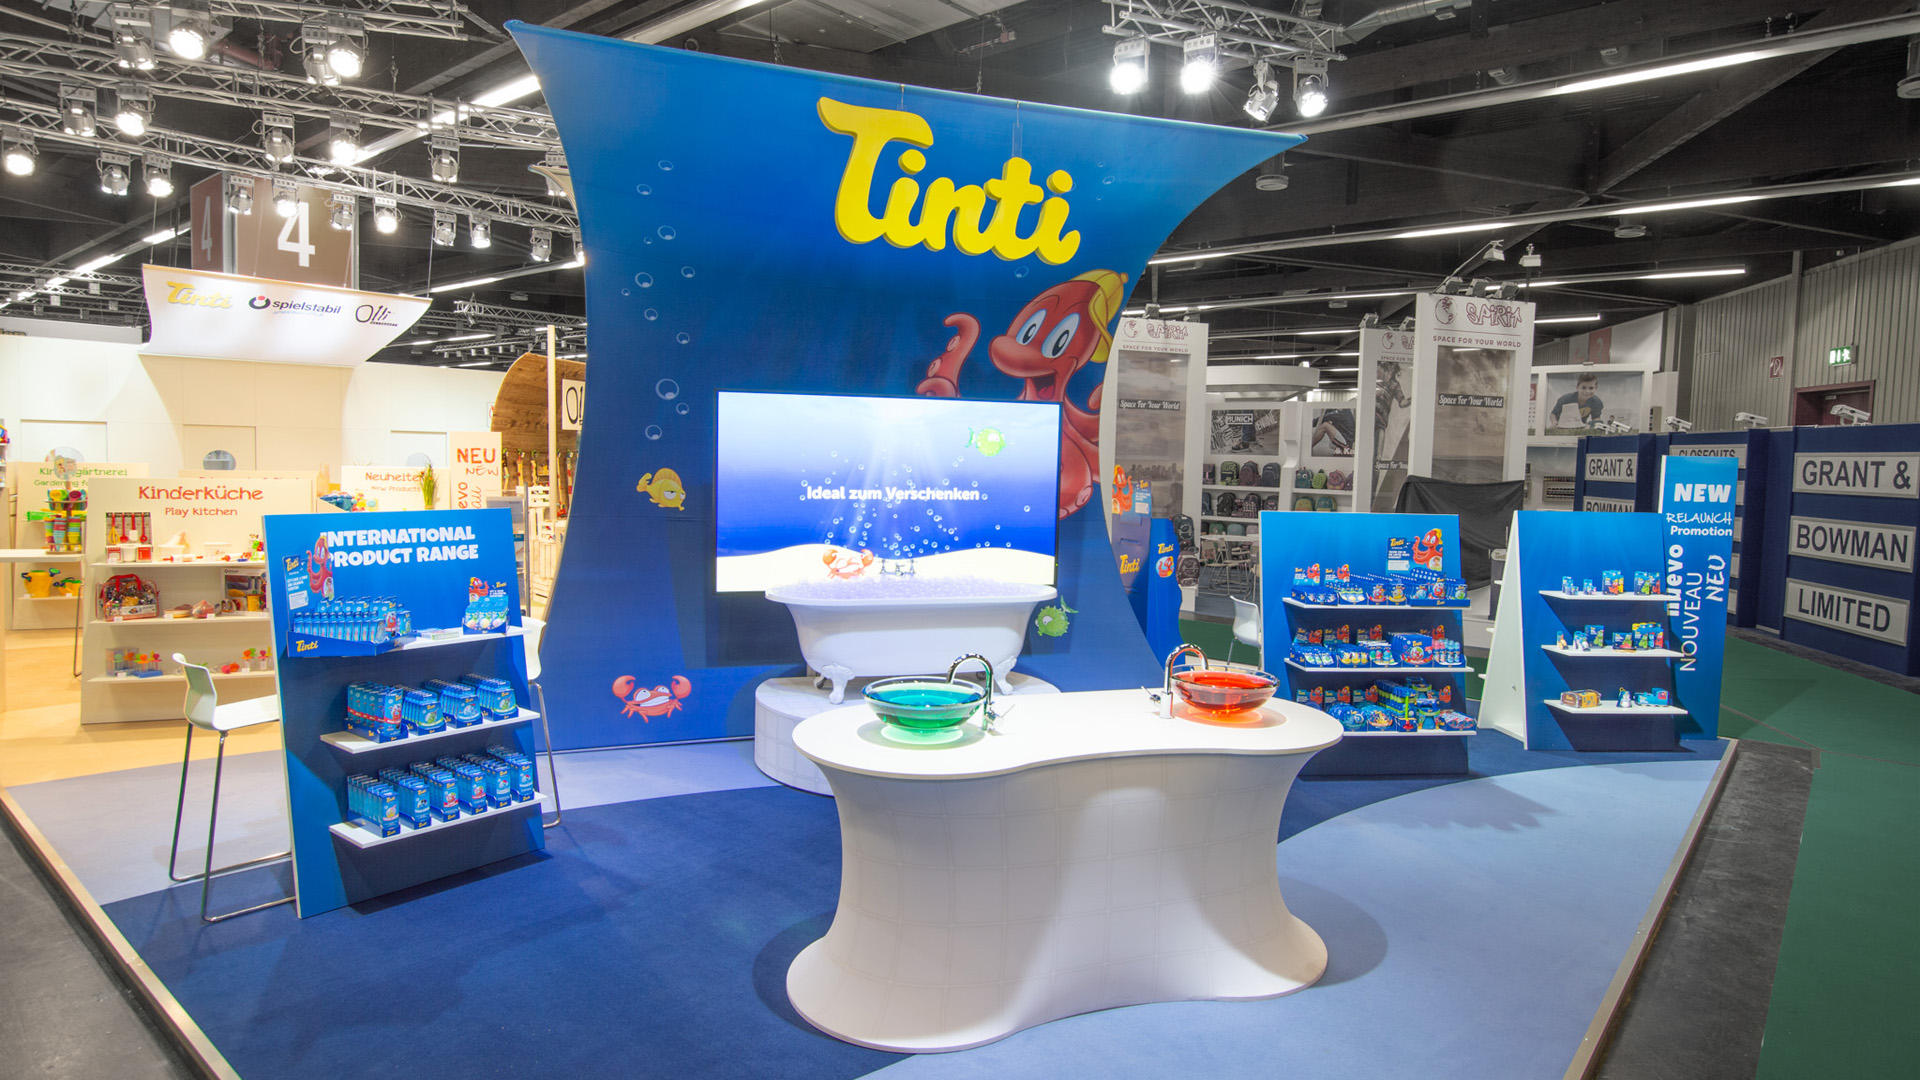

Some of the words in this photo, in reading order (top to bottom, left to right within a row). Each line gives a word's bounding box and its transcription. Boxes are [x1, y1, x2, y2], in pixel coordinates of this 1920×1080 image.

[817, 97, 1080, 265] Tinti
[202, 196, 212, 261] 4
[277, 202, 315, 267] 4
[167, 281, 233, 308] Tinti
[272, 300, 342, 314] spielstabil
[1475, 338, 1494, 346] YOUR
[1496, 340, 1521, 348] WORLD
[1120, 400, 1136, 410] Space
[1137, 400, 1147, 408] For
[1148, 401, 1161, 409] Your
[1162, 401, 1180, 410] World
[1439, 395, 1457, 406] Space
[1458, 396, 1467, 404] For
[1468, 396, 1483, 406] Your
[1483, 397, 1503, 407] World
[1225, 414, 1253, 424] MUNICH
[457, 448, 495, 463] NEU
[40, 467, 127, 478] Kingärtnerei
[466, 465, 498, 476] NEW
[1375, 461, 1390, 471] Space
[1589, 458, 1624, 476] GRANT
[1625, 459, 1633, 477] &
[1802, 460, 1886, 488] GRANT
[1893, 461, 1911, 490] &
[138, 485, 264, 500] Kinderküche
[806, 486, 846, 500] Ideal
[848, 489, 883, 500] zum
[885, 487, 980, 501] Verschenken
[1674, 483, 1732, 503] NEW
[165, 507, 189, 518] Play
[1666, 511, 1733, 525] RELAUNCH
[320, 526, 476, 547] NTERNATIONAL
[1670, 525, 1733, 536] Promotion
[1158, 543, 1175, 554] Tinti
[1796, 524, 1908, 563] BOWMAN
[416, 544, 479, 562] RANGE
[1119, 555, 1140, 574] Tinti
[1705, 555, 1726, 602] NEU
[1798, 588, 1890, 632] LIMITED
[1680, 572, 1703, 671] NOUVEAU
[296, 640, 318, 652] Tinti
